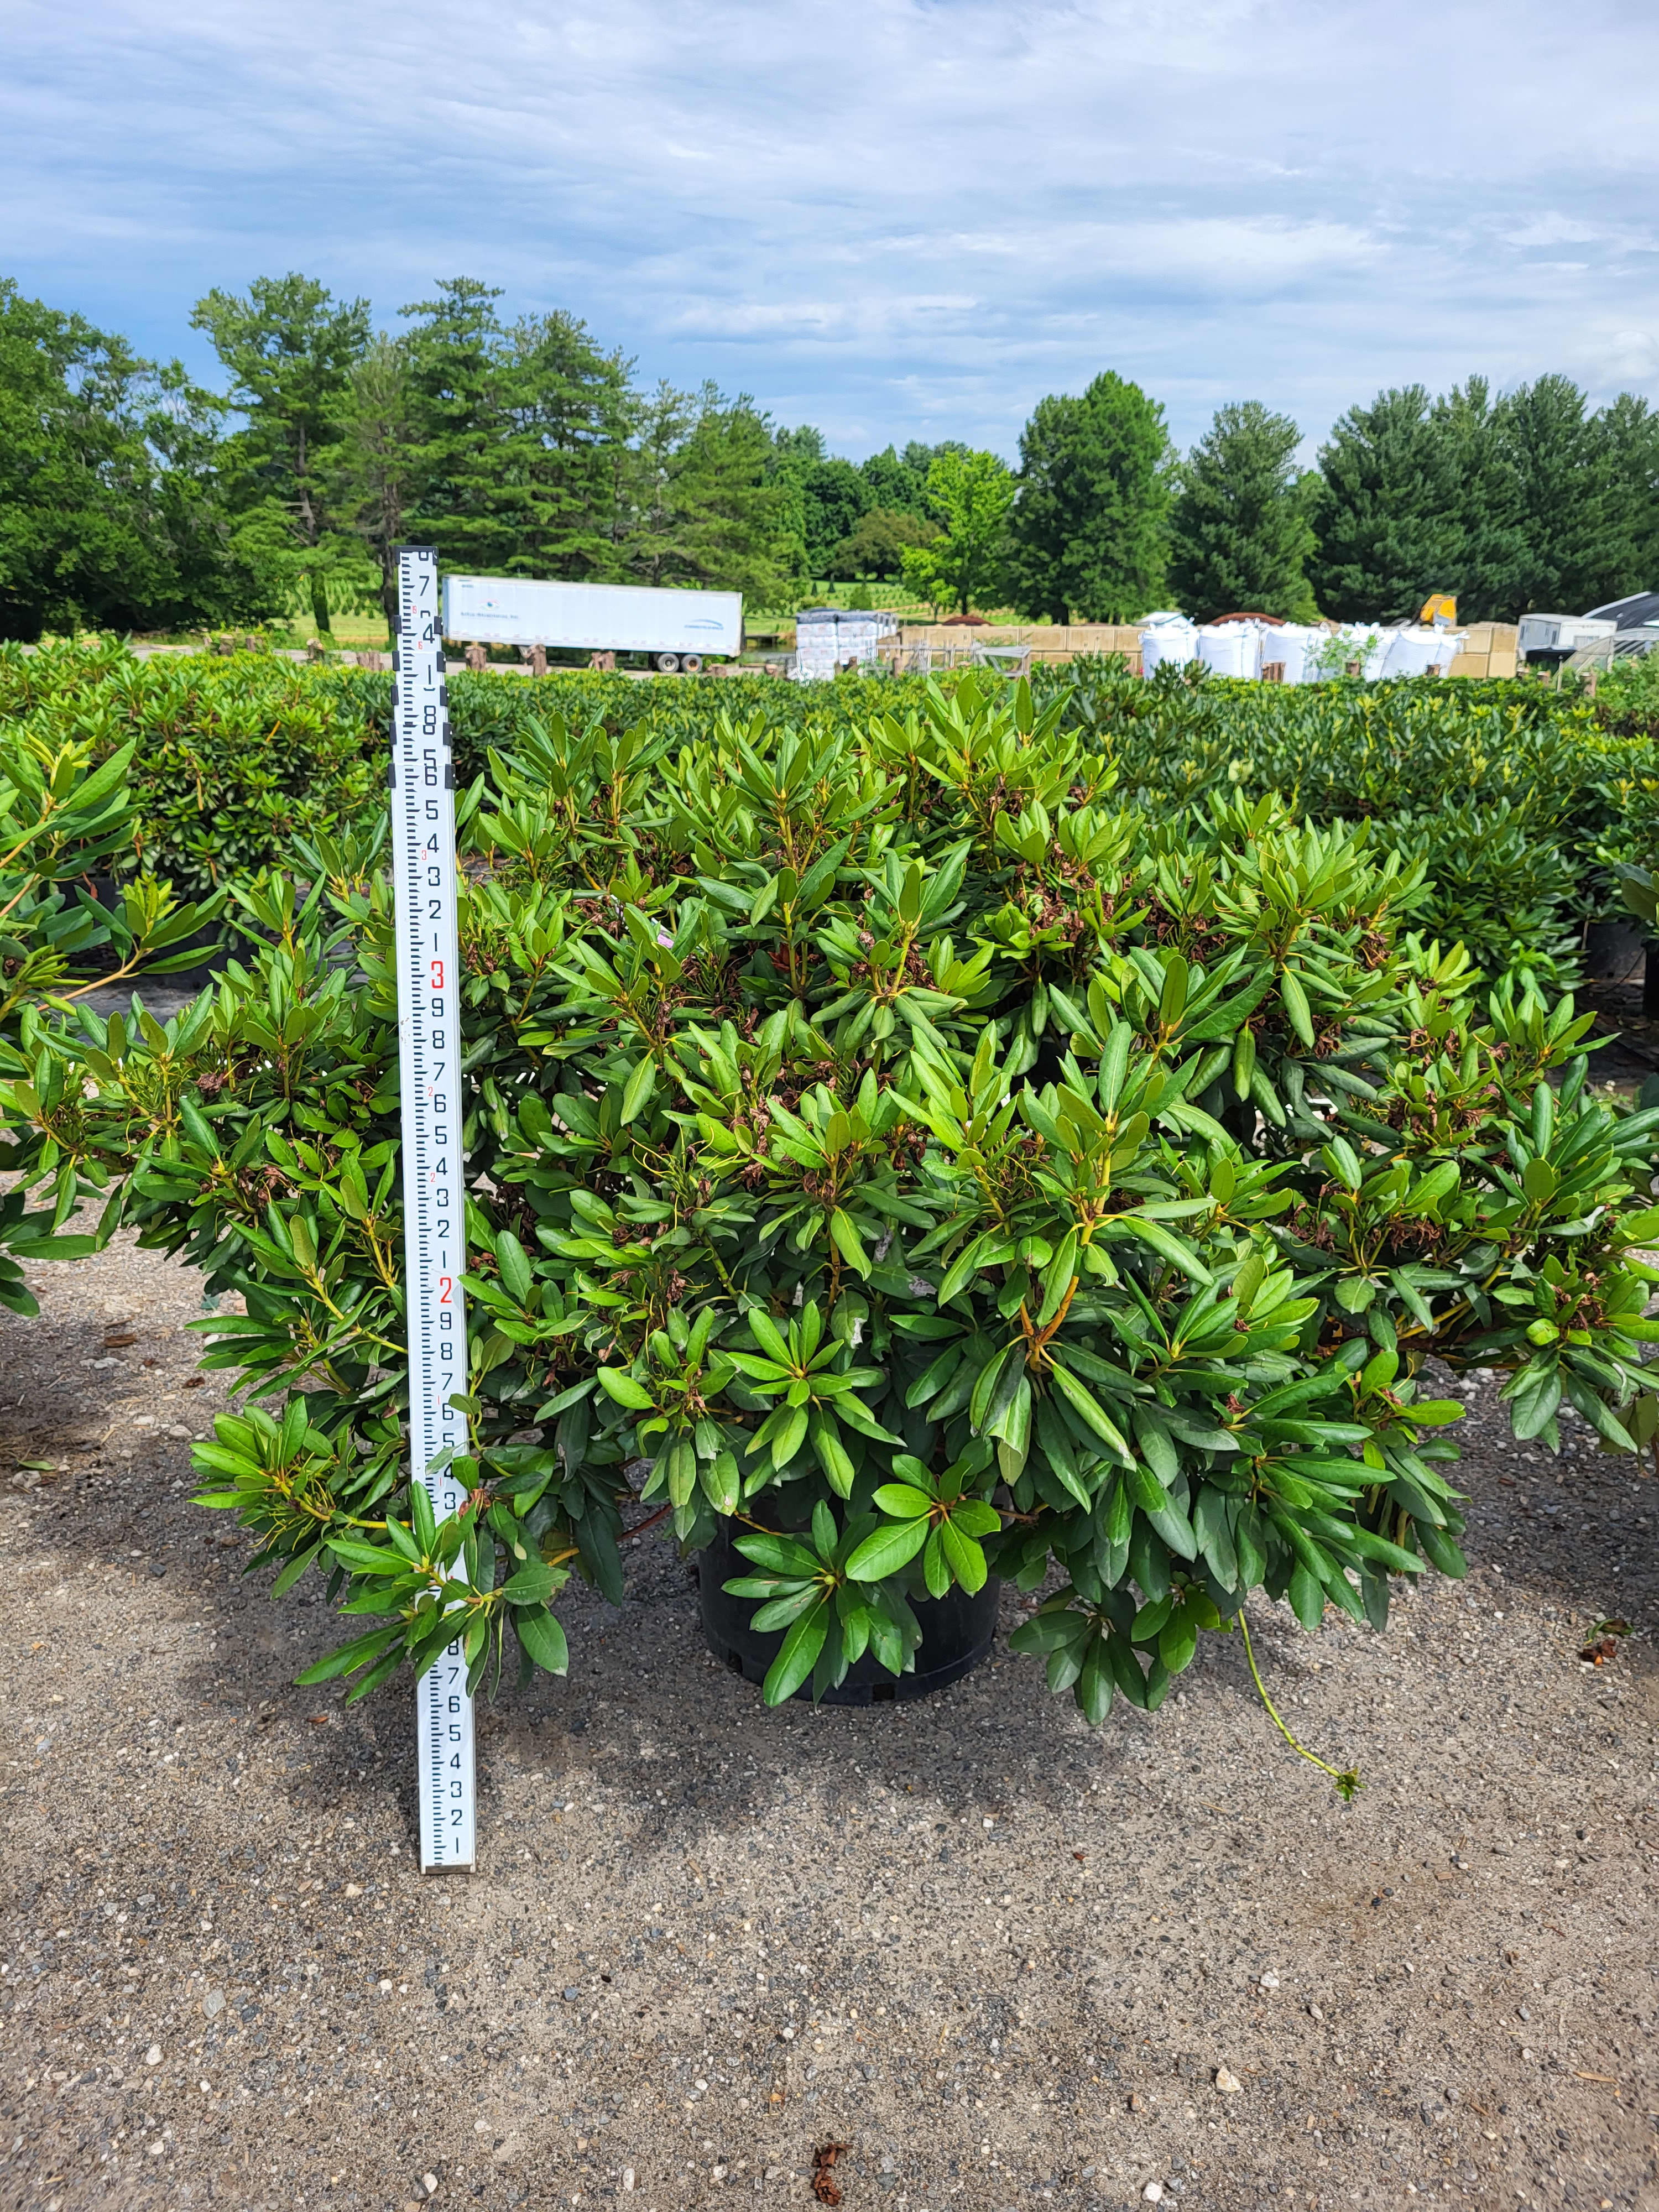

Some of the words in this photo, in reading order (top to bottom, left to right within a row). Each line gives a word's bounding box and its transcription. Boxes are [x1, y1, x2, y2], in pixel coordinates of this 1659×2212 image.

[419, 576, 430, 596] 7
[423, 623, 435, 644] 4
[424, 705, 436, 725] 8
[425, 766, 437, 786] 6
[425, 800, 439, 820] 5
[427, 833, 440, 853] 4
[421, 850, 427, 860] 3
[428, 867, 441, 886] 3
[429, 900, 441, 919] 2
[434, 932, 438, 952] 1
[431, 960, 444, 989] 3
[431, 998, 444, 1018] 9
[432, 1030, 445, 1049] 8
[434, 1062, 446, 1081] 7
[428, 1087, 434, 1097] 2
[434, 1094, 447, 1113] 6
[435, 1126, 447, 1145] 5
[436, 1157, 448, 1176] 4
[430, 1172, 436, 1182] 2
[437, 1188, 449, 1207] 3
[438, 1220, 450, 1238] 2
[443, 1250, 446, 1269] 1
[440, 1276, 452, 1303] 2
[440, 1312, 452, 1330] 9
[441, 1343, 453, 1360] 8
[441, 1373, 453, 1391] 7
[442, 1403, 454, 1421] 6
[443, 1433, 455, 1447] 5
[444, 1492, 456, 1510] 3
[447, 1640, 459, 1656] 8
[448, 1667, 460, 1684] 7
[448, 1695, 460, 1713] 6
[449, 1724, 461, 1742] 5
[450, 1753, 461, 1770] 4
[451, 1781, 462, 1798] 3
[451, 1809, 462, 1825] 2
[456, 1837, 458, 1854] 1
